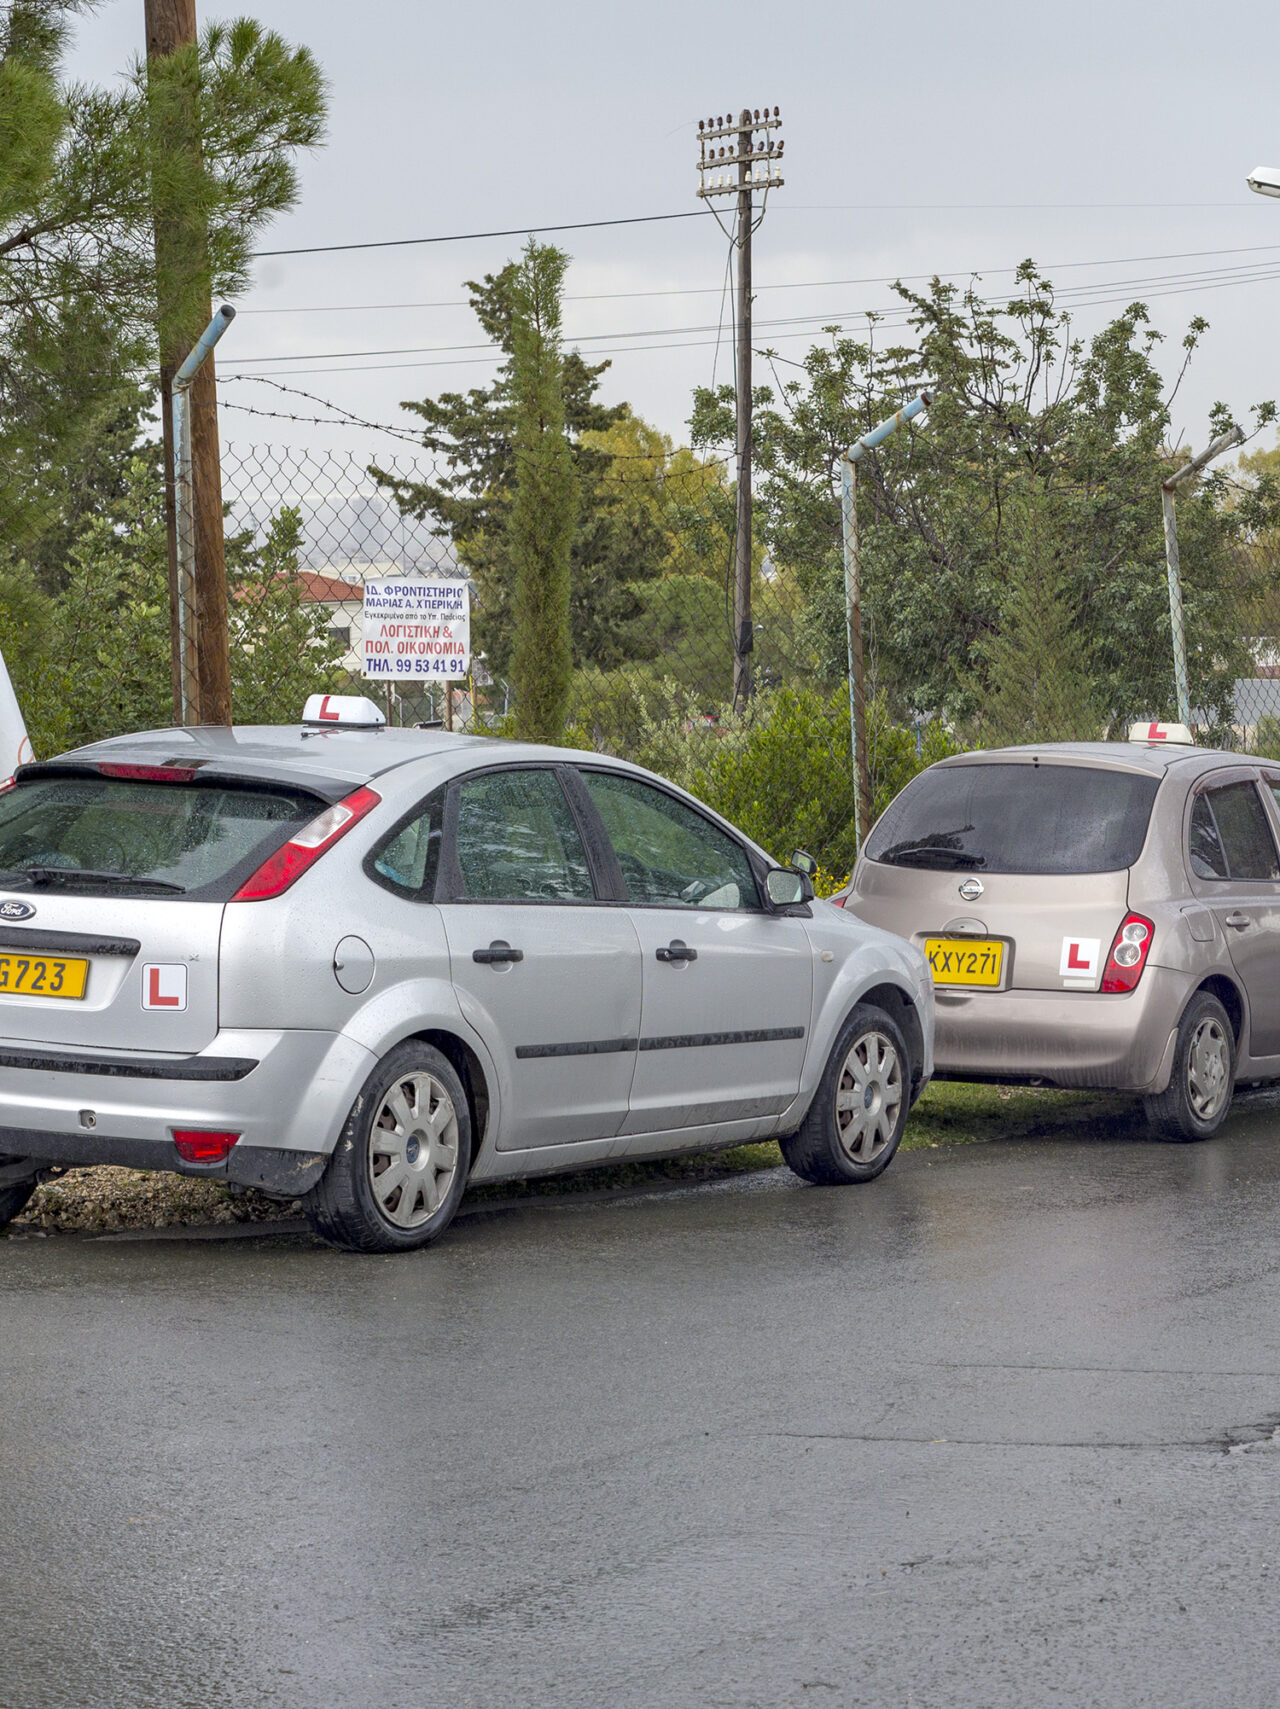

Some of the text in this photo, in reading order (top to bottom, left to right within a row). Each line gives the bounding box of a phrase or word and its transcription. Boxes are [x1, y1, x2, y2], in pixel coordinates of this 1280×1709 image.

[366, 598, 403, 609] ΜΑΡΙΑΣ
[380, 624, 453, 638] ΛΟΓΙΣΤΙΚΗ &
[365, 640, 465, 655] ΠΟΛ. ΟΙΚΟΝΟΜΙΑ
[366, 658, 465, 673] ΤΗΛ. 99 53 41 91
[318, 695, 340, 720] L
[1148, 722, 1167, 739] L
[0, 902, 24, 916] Ford
[928, 951, 997, 975] KXY271
[1067, 943, 1090, 969] L
[149, 968, 179, 1006] L
